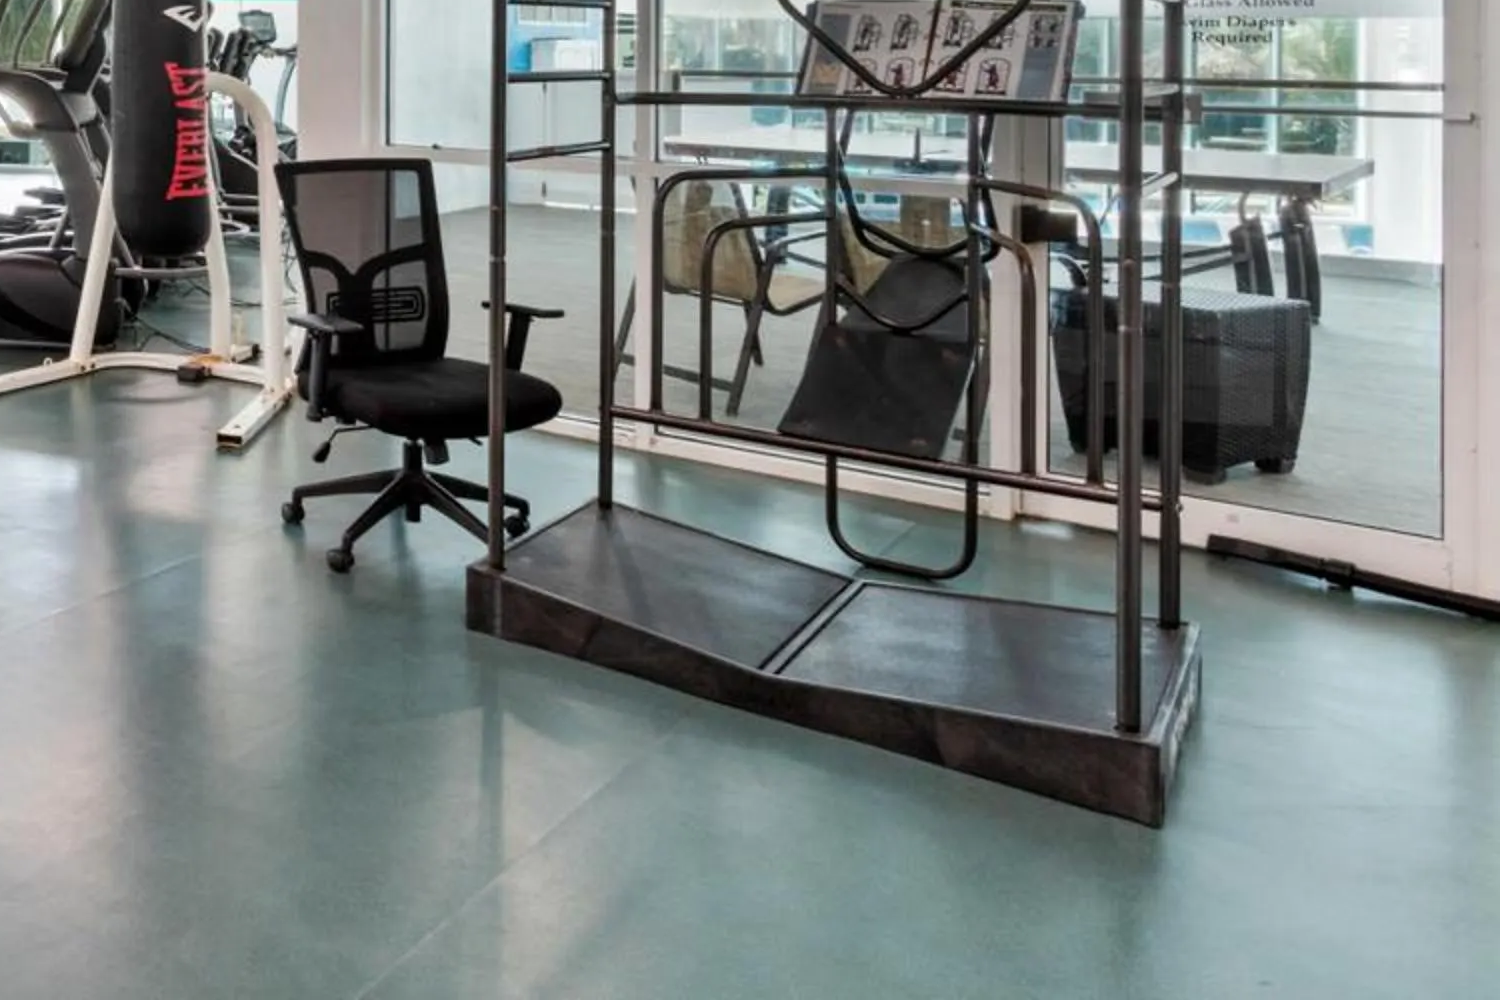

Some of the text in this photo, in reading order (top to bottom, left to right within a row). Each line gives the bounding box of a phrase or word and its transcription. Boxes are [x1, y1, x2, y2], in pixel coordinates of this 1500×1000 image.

[1227, 15, 1297, 30] Diapers
[1191, 31, 1273, 46] Required
[165, 62, 210, 200] EVERLAST
